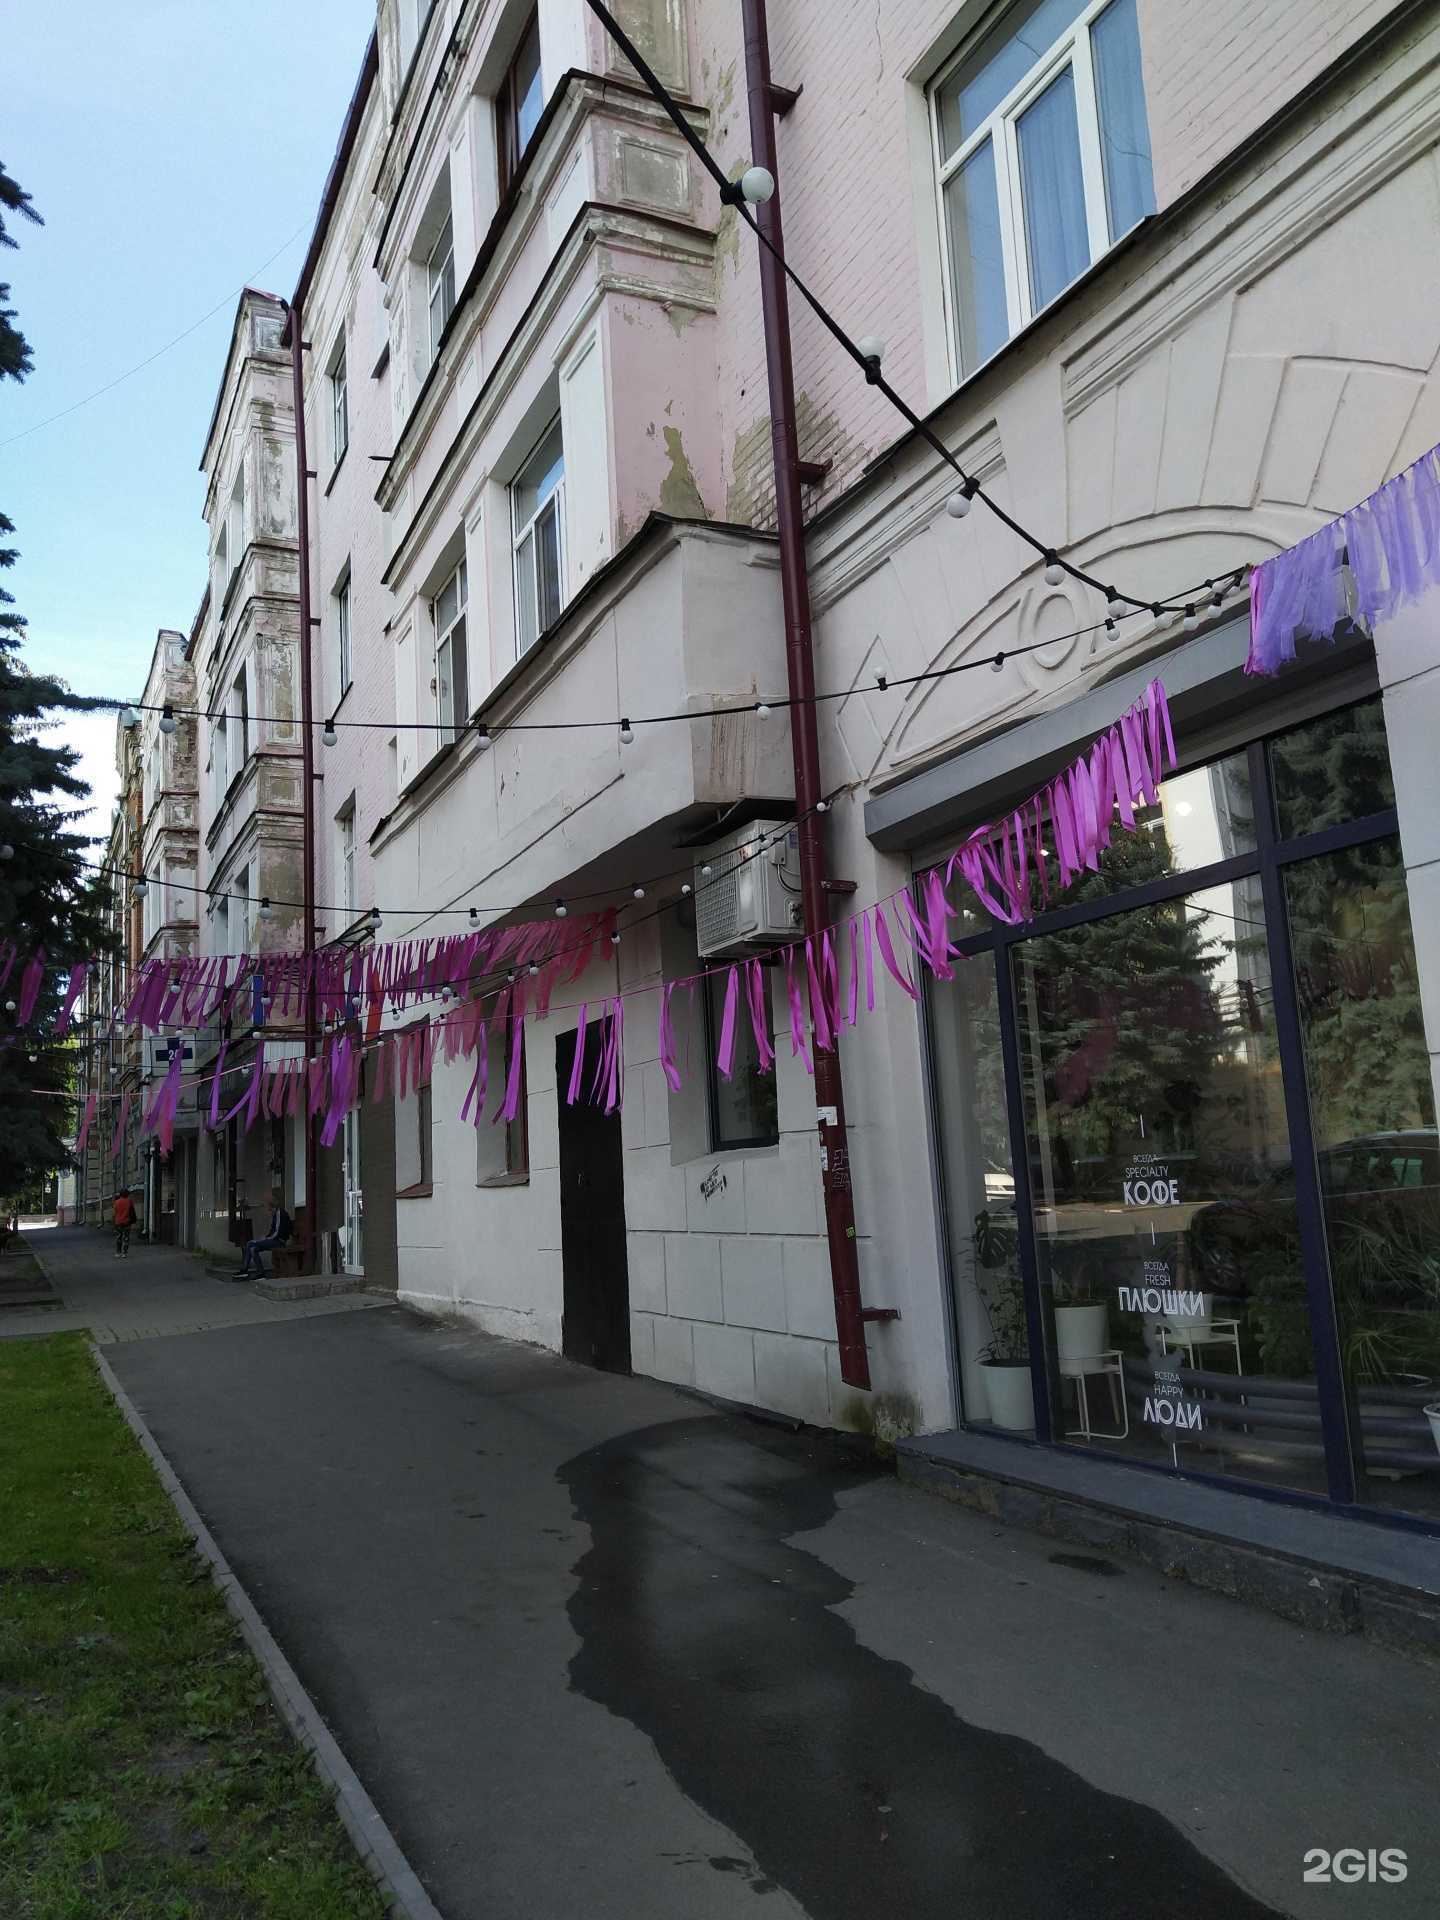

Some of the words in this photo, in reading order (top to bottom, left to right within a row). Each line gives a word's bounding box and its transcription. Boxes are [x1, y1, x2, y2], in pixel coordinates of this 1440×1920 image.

[1125, 1166, 1169, 1178] SPECIALTY
[1123, 1180, 1180, 1205] КОФЕ
[1143, 1261, 1169, 1271] ВСЕГДА
[1145, 1274, 1171, 1286] FRESH
[1118, 1287, 1205, 1317] ПЛЮШКИ
[1154, 1370, 1181, 1382] ВСЕГДА
[1154, 1384, 1184, 1398] HAPPY
[1143, 1397, 1203, 1431] ЛЮДИ
